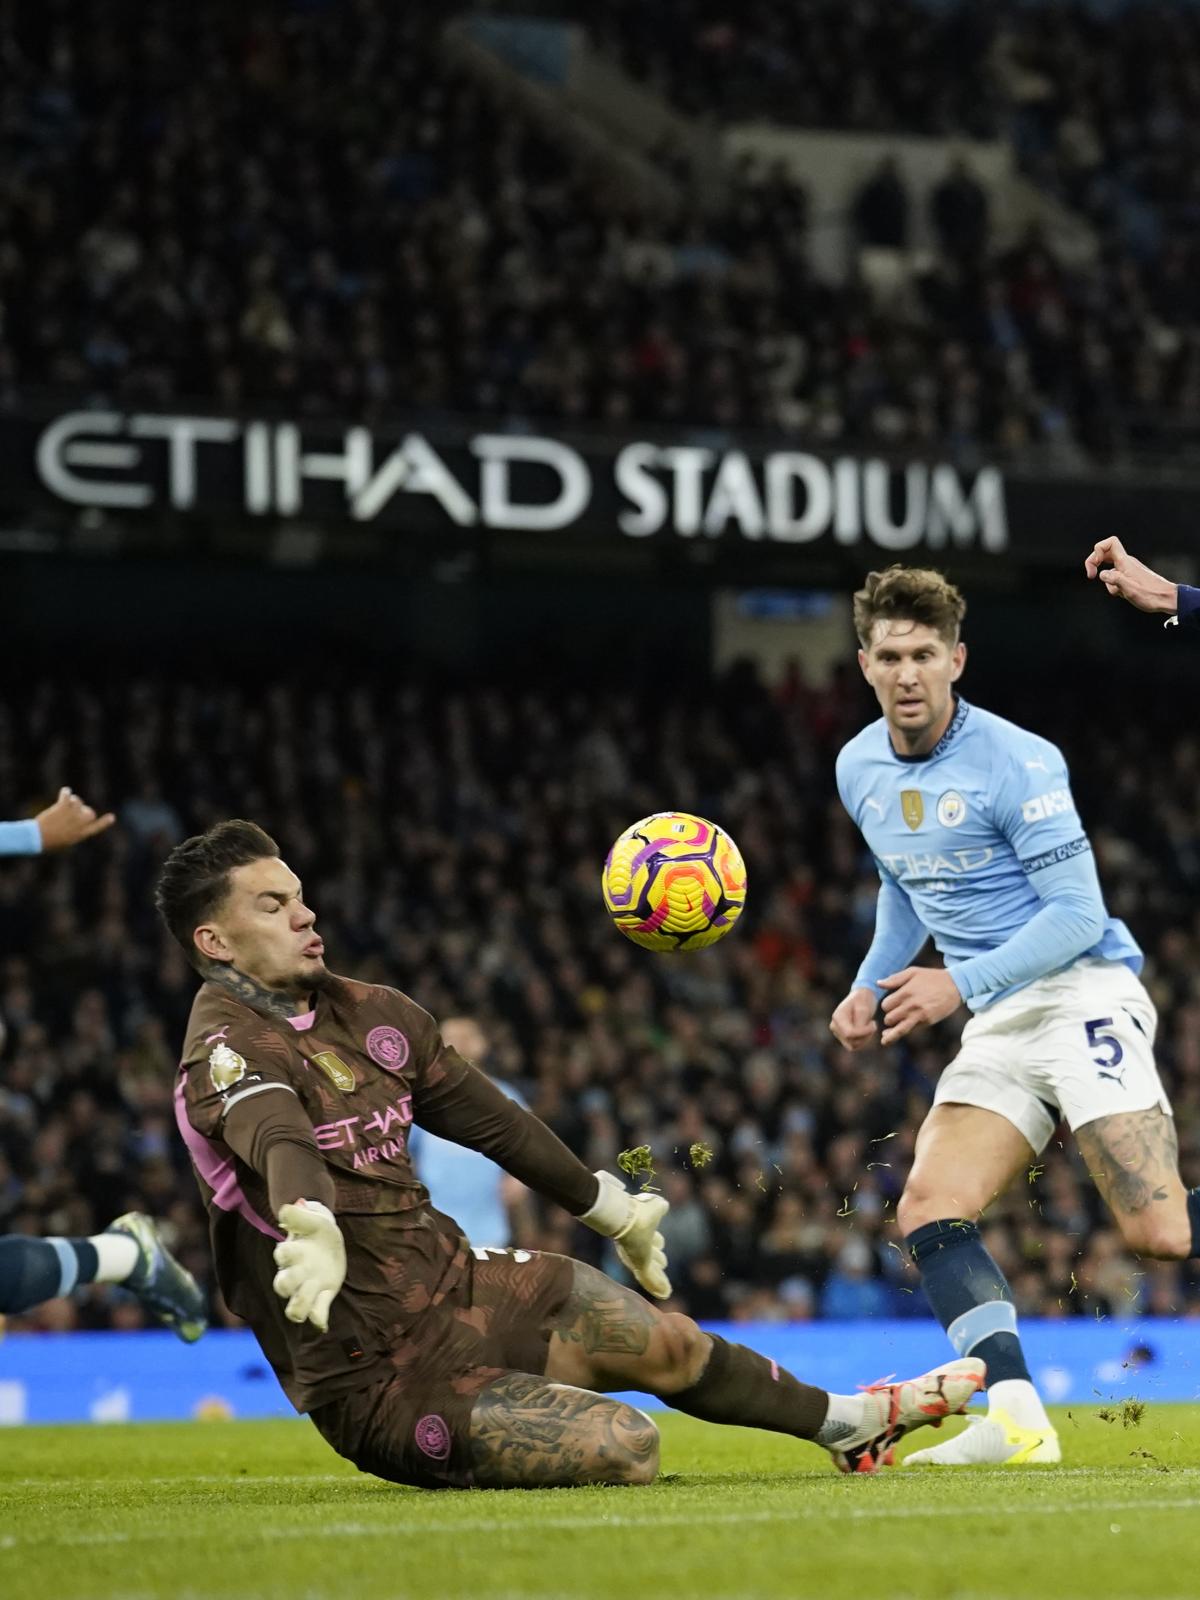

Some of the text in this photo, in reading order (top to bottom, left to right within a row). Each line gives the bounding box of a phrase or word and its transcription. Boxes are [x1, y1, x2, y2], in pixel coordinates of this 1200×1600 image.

[36, 410, 1008, 553] ETIHAD STADIUM
[878, 847, 993, 876] TIHAD
[1084, 1017, 1123, 1068] 5
